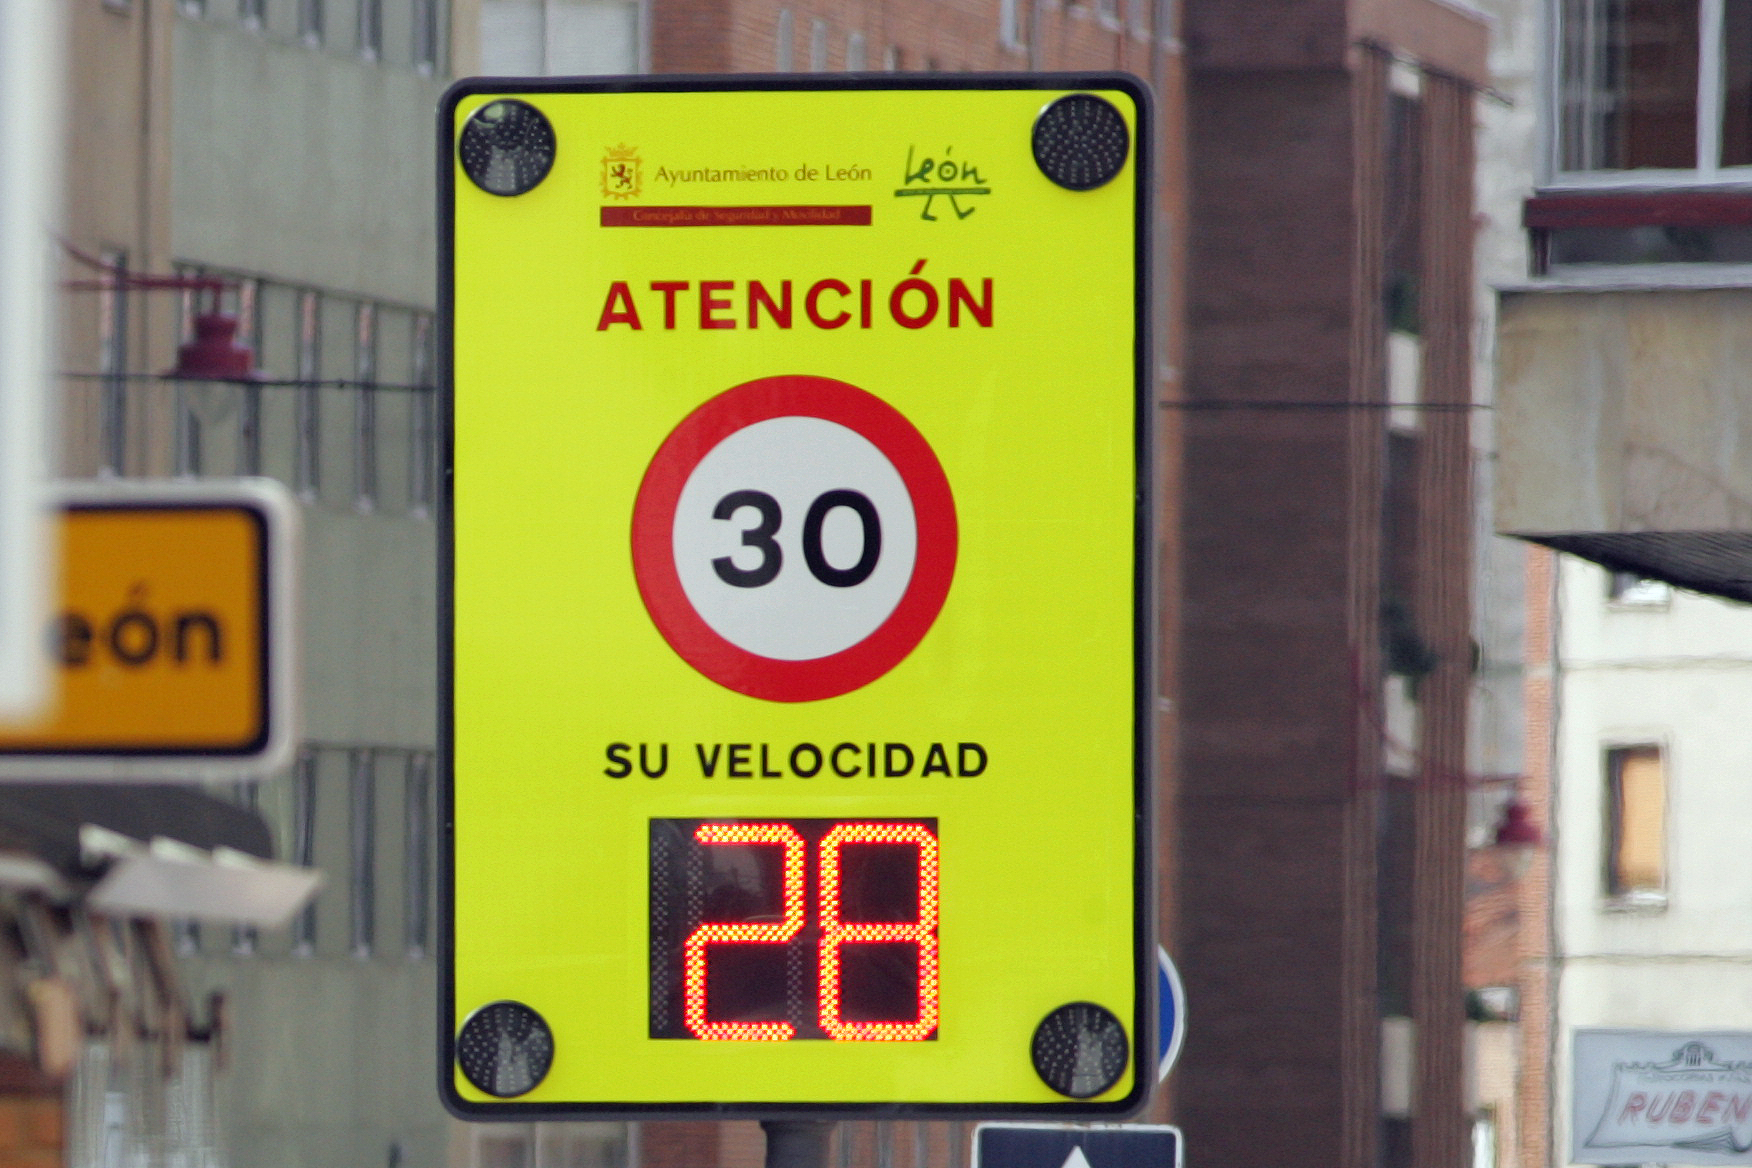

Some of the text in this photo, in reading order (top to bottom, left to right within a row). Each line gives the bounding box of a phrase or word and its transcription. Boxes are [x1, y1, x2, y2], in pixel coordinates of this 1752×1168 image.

[653, 162, 872, 187] Ayuntamiento de León
[904, 144, 988, 187] León
[595, 258, 994, 332] ATENCIÓN
[710, 488, 883, 589] 30
[44, 578, 222, 667] eón
[603, 741, 990, 780] SU VELOCIDAD
[682, 823, 940, 1042] 28
